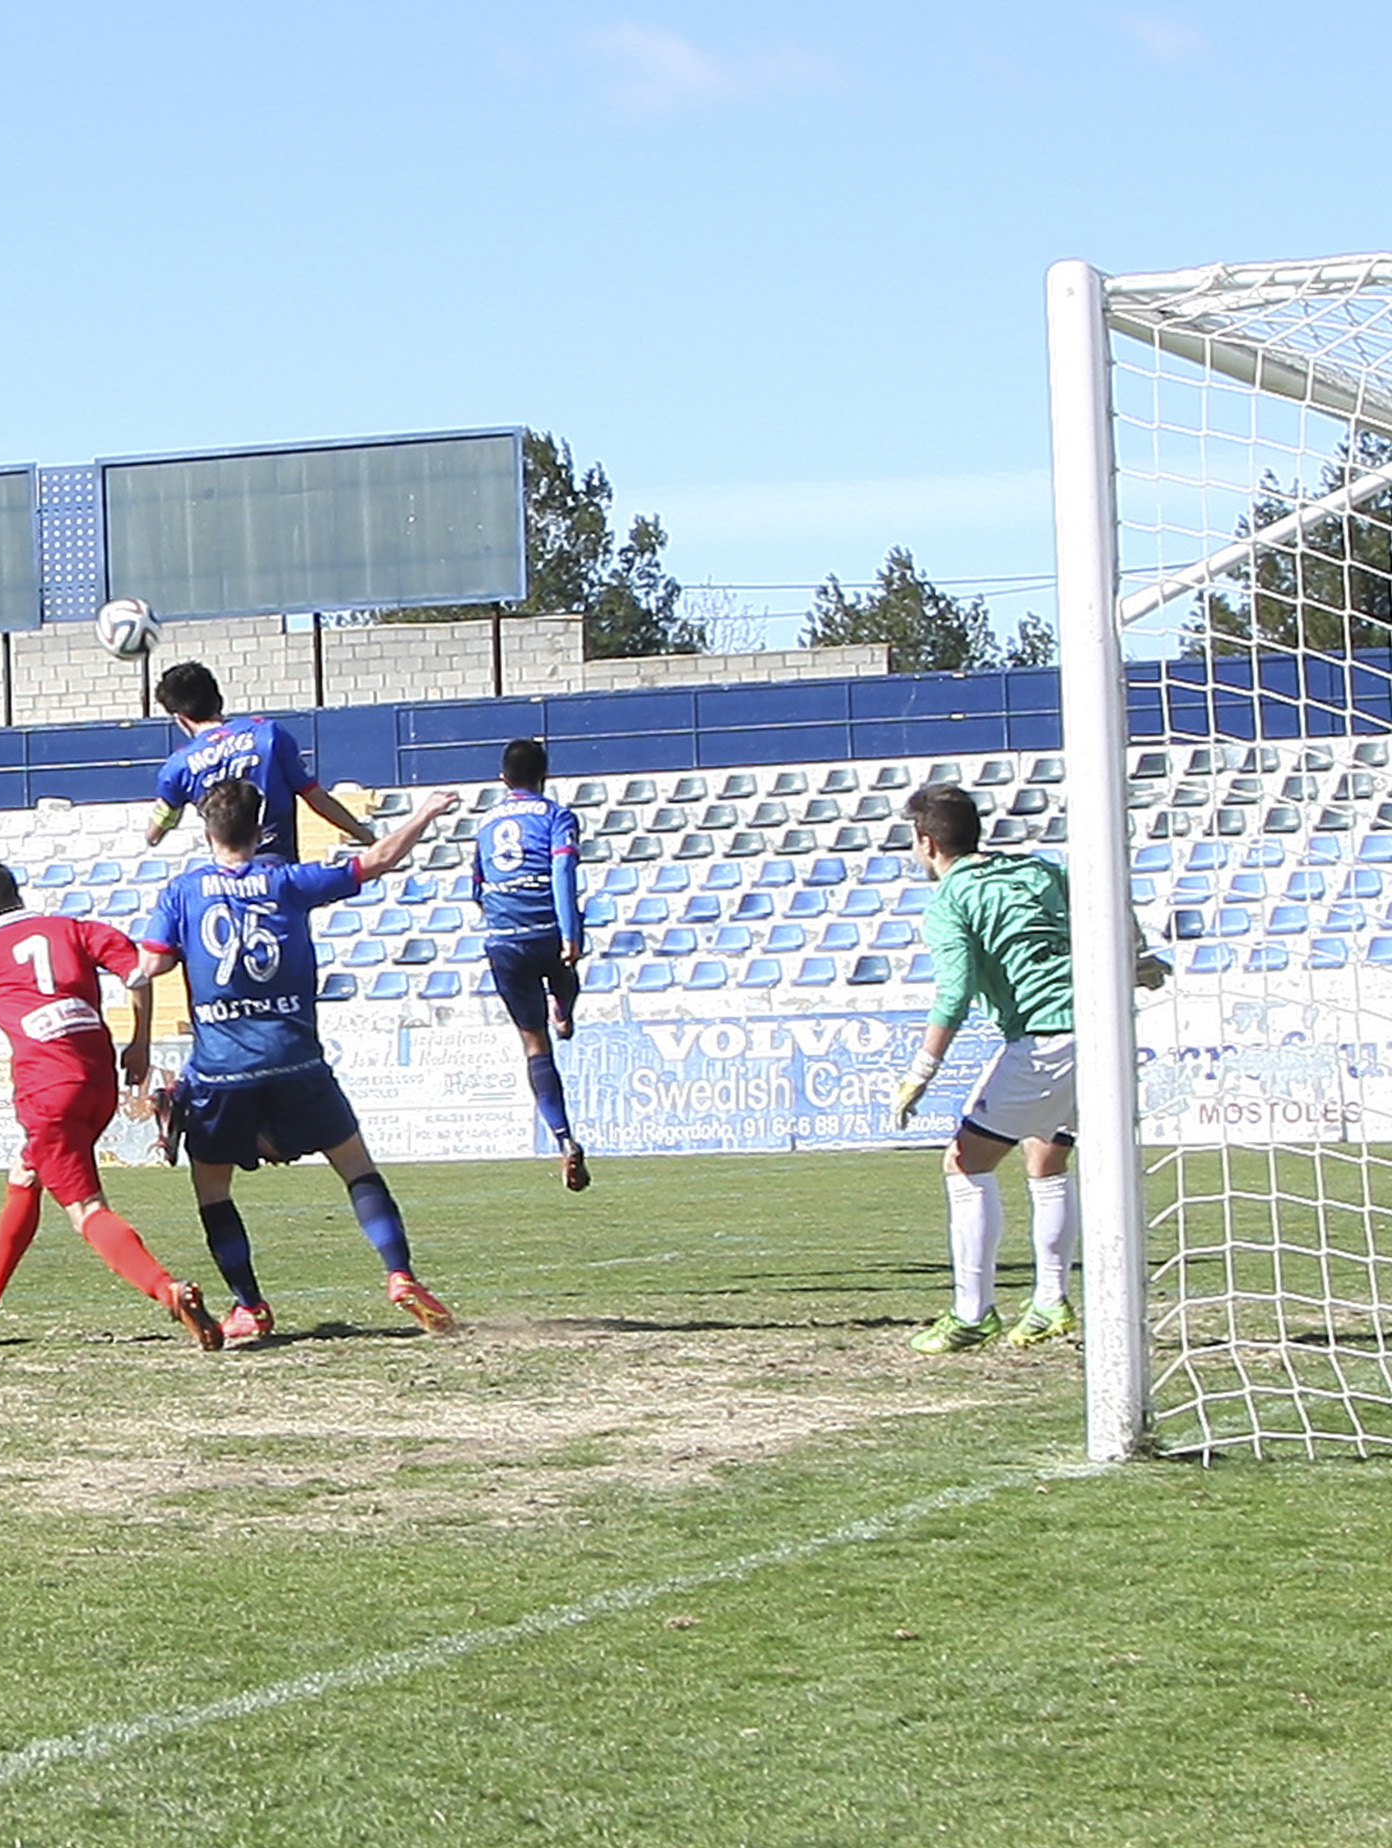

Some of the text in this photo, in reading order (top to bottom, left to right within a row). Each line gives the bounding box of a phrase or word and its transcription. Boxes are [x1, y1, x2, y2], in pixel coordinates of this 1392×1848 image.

[492, 818, 525, 872] 8
[200, 901, 281, 986] 95
[642, 1018, 892, 1061] VOLVO
[630, 1064, 795, 1113] Swedish
[805, 1061, 898, 1108] Cars
[743, 1117, 766, 1139] 91
[814, 1114, 839, 1136] 88
